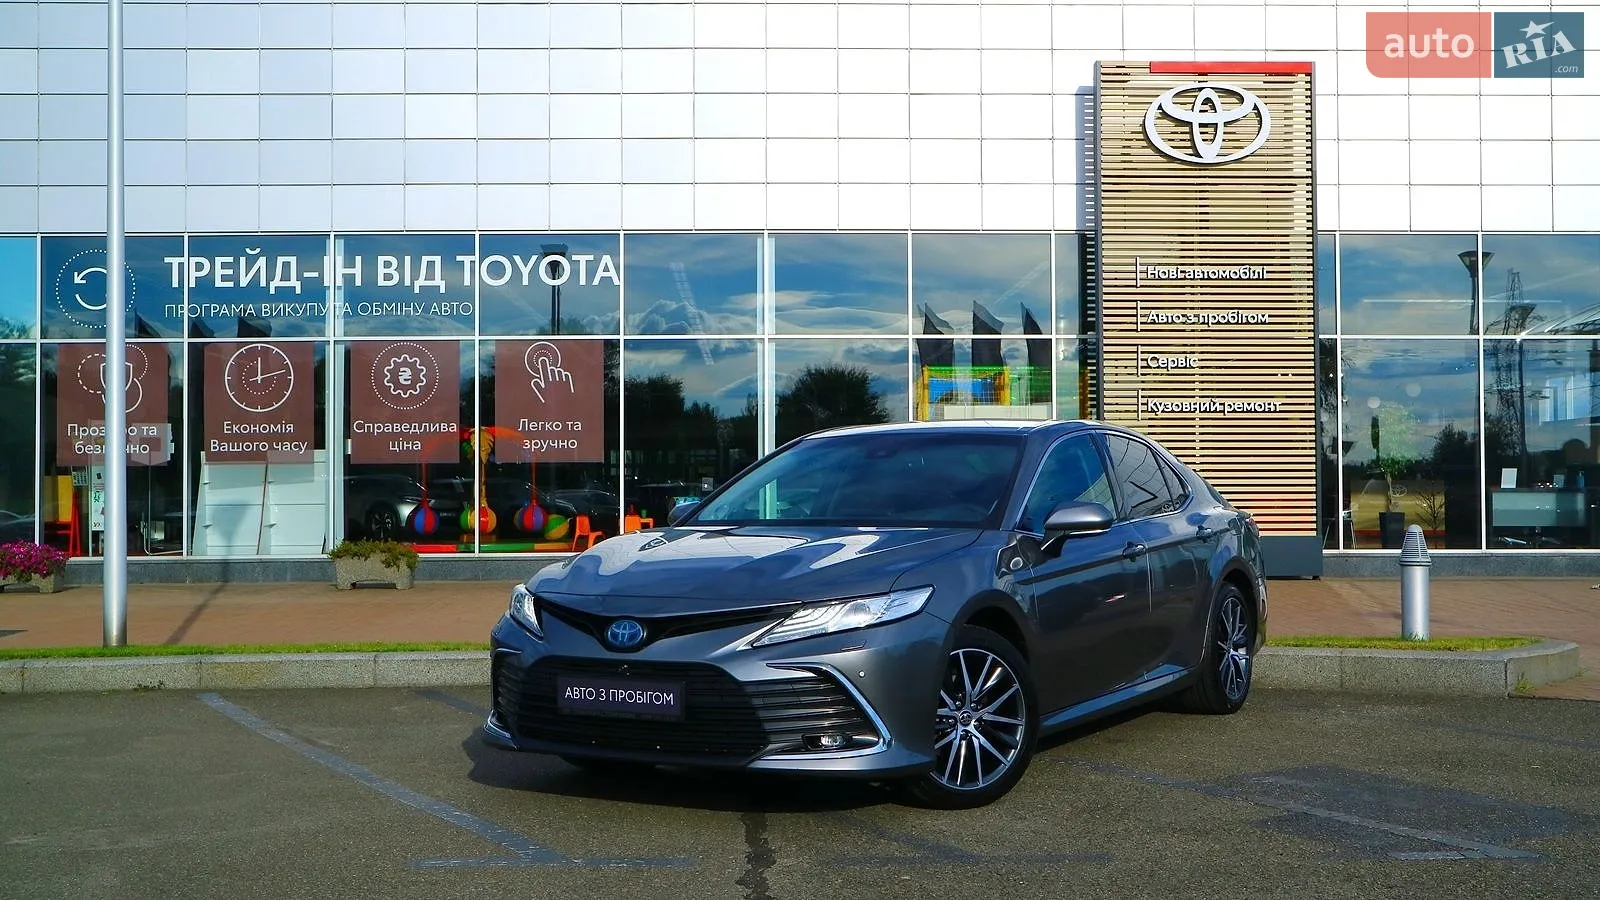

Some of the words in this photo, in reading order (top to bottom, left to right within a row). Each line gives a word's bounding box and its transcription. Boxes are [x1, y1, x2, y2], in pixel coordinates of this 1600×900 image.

[164, 247, 362, 294] ТРЕЙД-ІН
[377, 255, 445, 294] ВІД
[456, 254, 620, 286] TOYOTA
[1147, 265, 1180, 279] Нові
[1185, 264, 1267, 279] автомобілі
[165, 303, 256, 317] ПРОГРАМА
[261, 303, 329, 317] ВИКУПУ
[333, 302, 352, 316] ТА
[357, 302, 425, 316] ОБМІНУ
[429, 301, 473, 316] АВТО
[1147, 311, 1182, 323] Авто
[1186, 313, 1194, 323] з
[1200, 310, 1269, 327] пробігом
[1147, 354, 1199, 371] Сервіс
[1147, 398, 1219, 416] Кузовний
[1224, 402, 1281, 416] ремонт
[67, 424, 137, 439] Прозо
[141, 426, 157, 436] та
[223, 420, 294, 434] Економія
[353, 420, 457, 435] Справедлива
[518, 418, 562, 431] Легко
[566, 421, 582, 431] та
[210, 440, 269, 452] Вашого
[273, 441, 308, 454] часу
[389, 438, 421, 452] ціна
[522, 439, 578, 452] зручно
[565, 686, 596, 700] АВТО
[609, 689, 674, 706] ПРОБІГОМ
